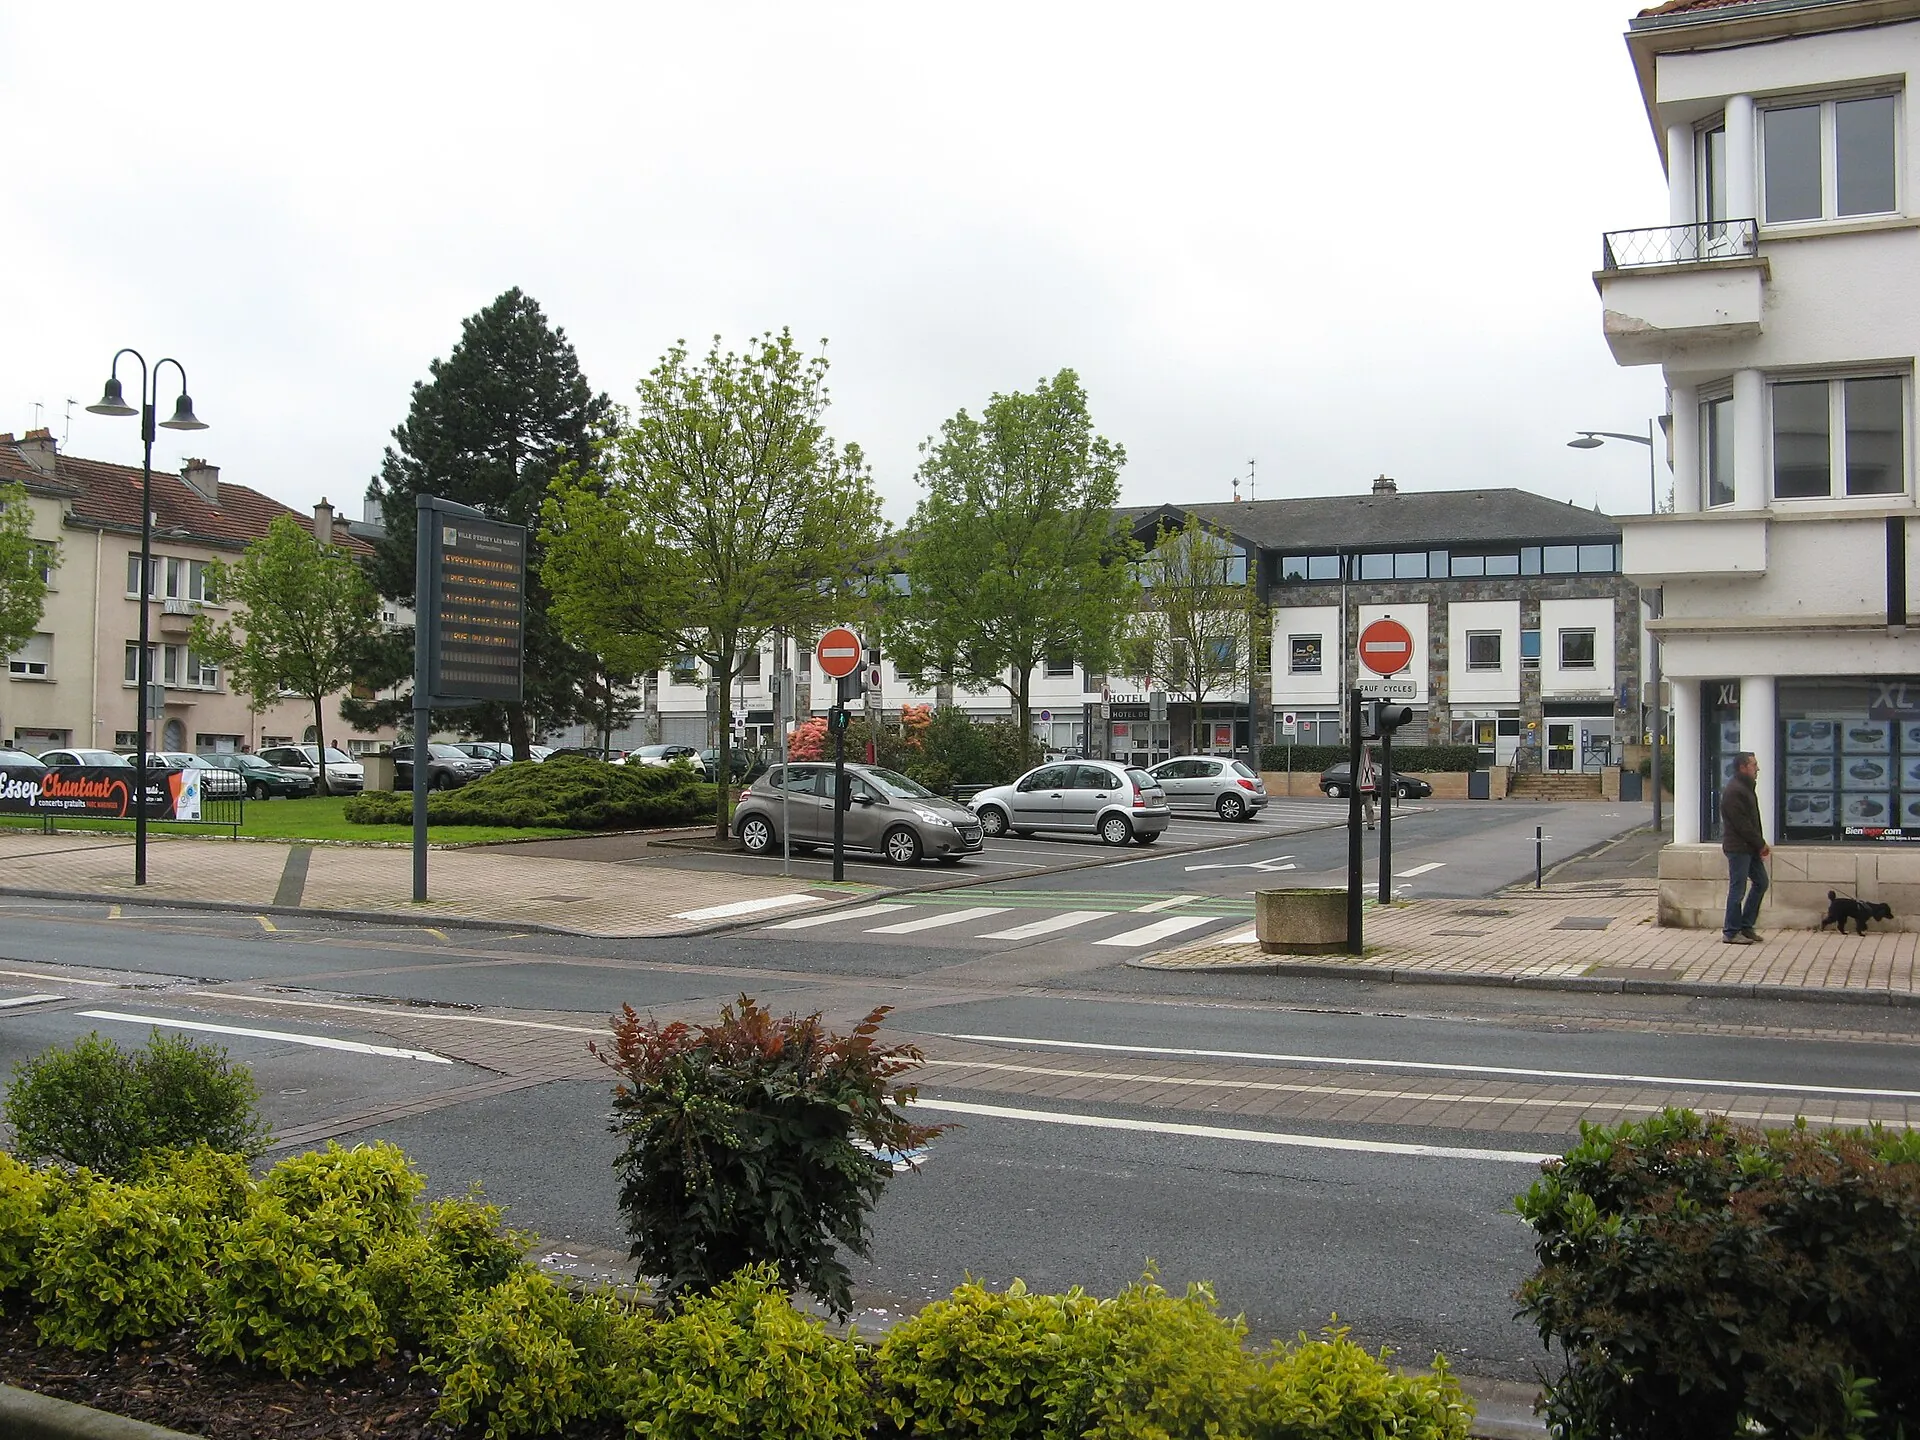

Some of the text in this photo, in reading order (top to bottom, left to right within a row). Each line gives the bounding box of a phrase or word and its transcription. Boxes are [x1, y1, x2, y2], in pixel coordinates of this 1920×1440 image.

[1109, 694, 1146, 703] HOTEL
[1717, 684, 1738, 704] XL
[1871, 682, 1914, 709] XL
[42, 773, 127, 802] Chantant
[38, 799, 63, 807] concerts
[64, 799, 86, 809] gratuits
